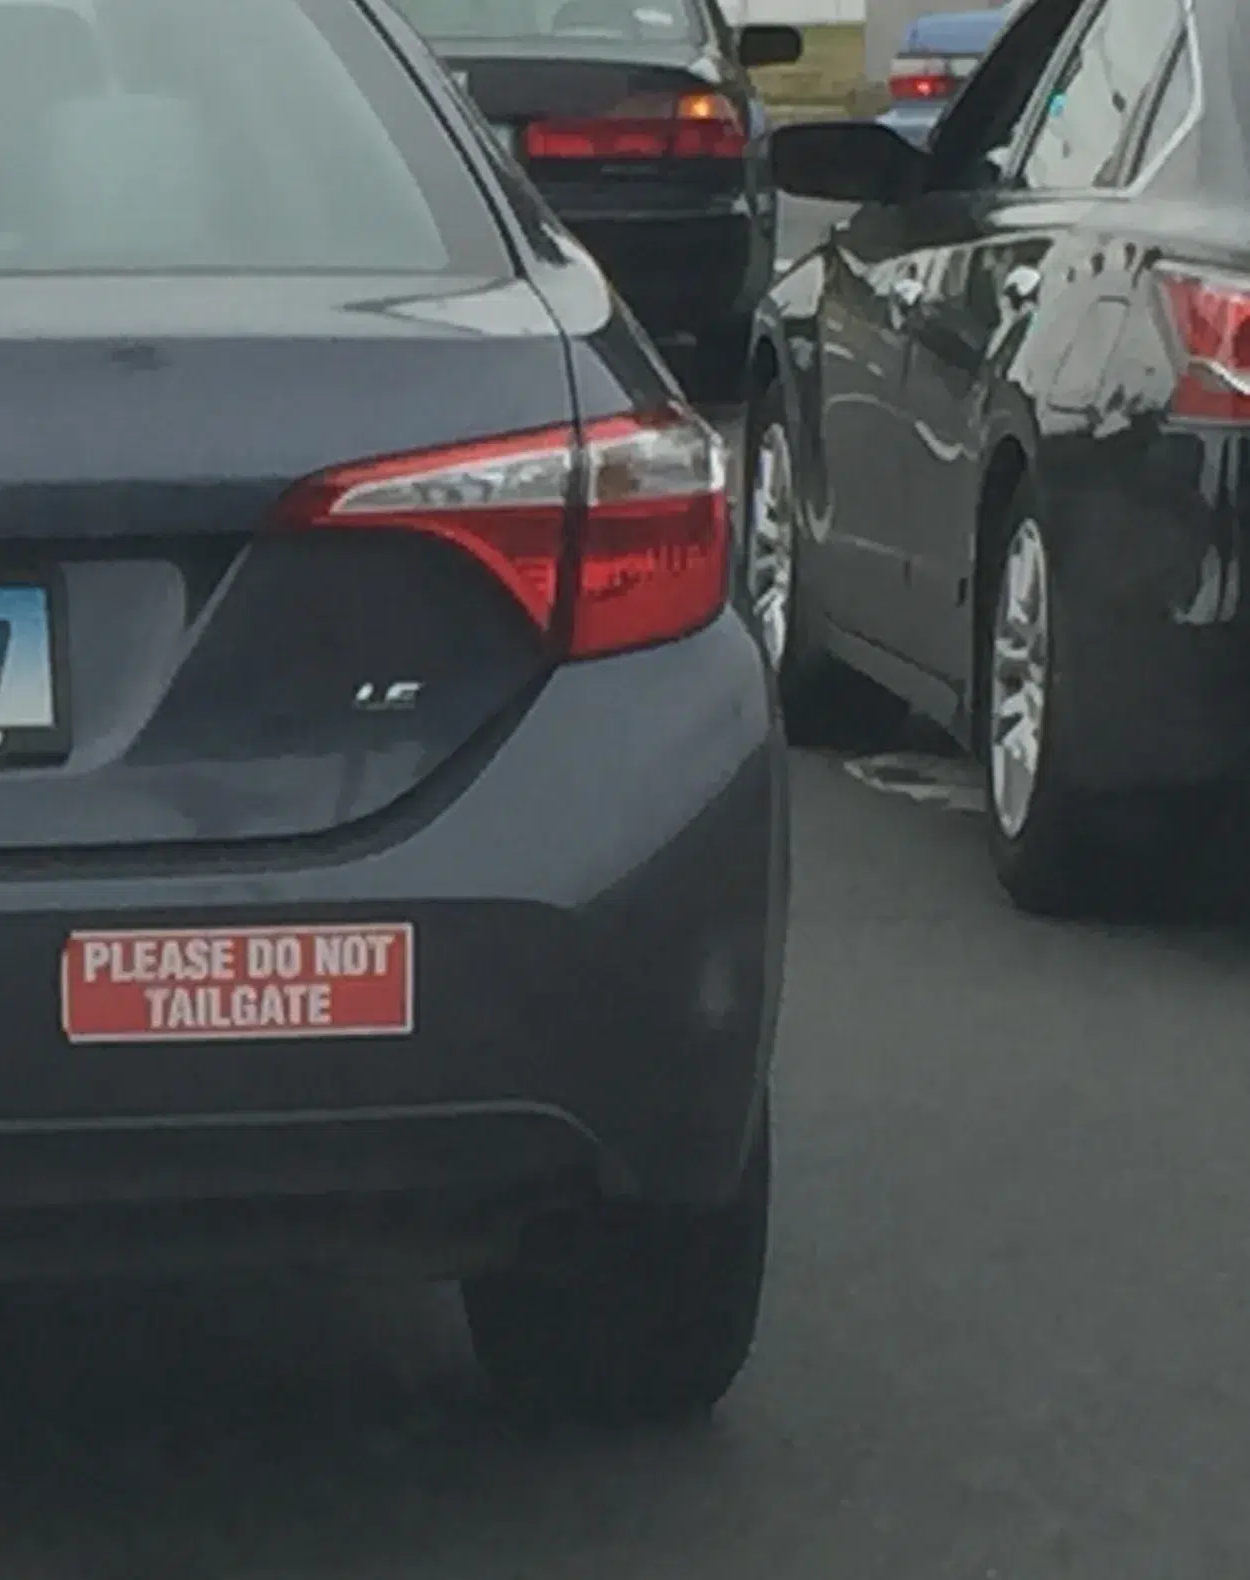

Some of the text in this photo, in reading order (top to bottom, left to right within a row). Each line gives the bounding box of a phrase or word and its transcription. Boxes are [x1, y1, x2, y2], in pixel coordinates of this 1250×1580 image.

[83, 933, 398, 983] PLEASE DO NOT
[144, 984, 334, 1029] TAILGATE
